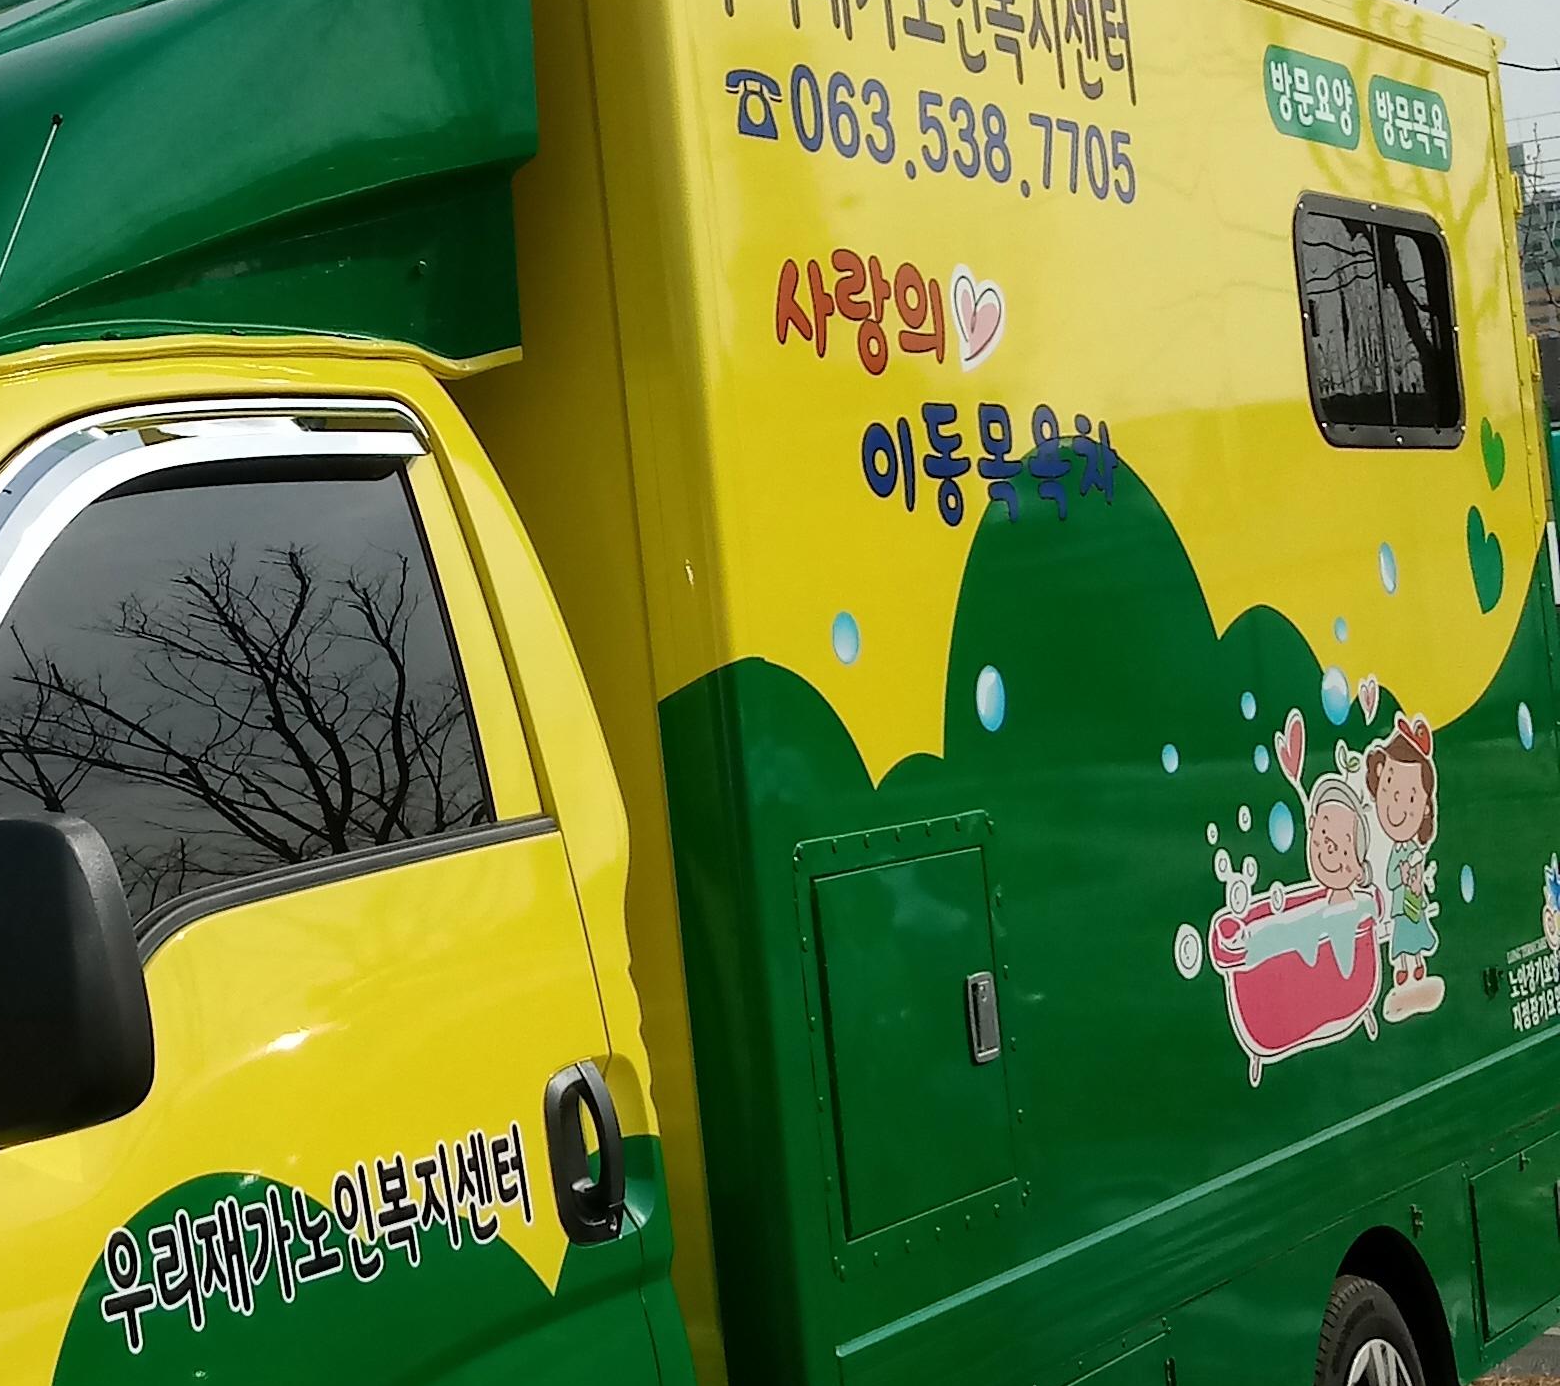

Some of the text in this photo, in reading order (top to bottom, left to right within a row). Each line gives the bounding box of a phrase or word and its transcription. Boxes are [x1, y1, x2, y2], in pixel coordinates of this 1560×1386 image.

[790, 63, 1138, 205] 063.538.7705
[1269, 60, 1449, 159] 방문요양 방문목욕
[775, 248, 947, 376] 사랑의
[861, 402, 1119, 528] 이동목욕차
[101, 1120, 535, 1355] 우리재가노인복지센터
